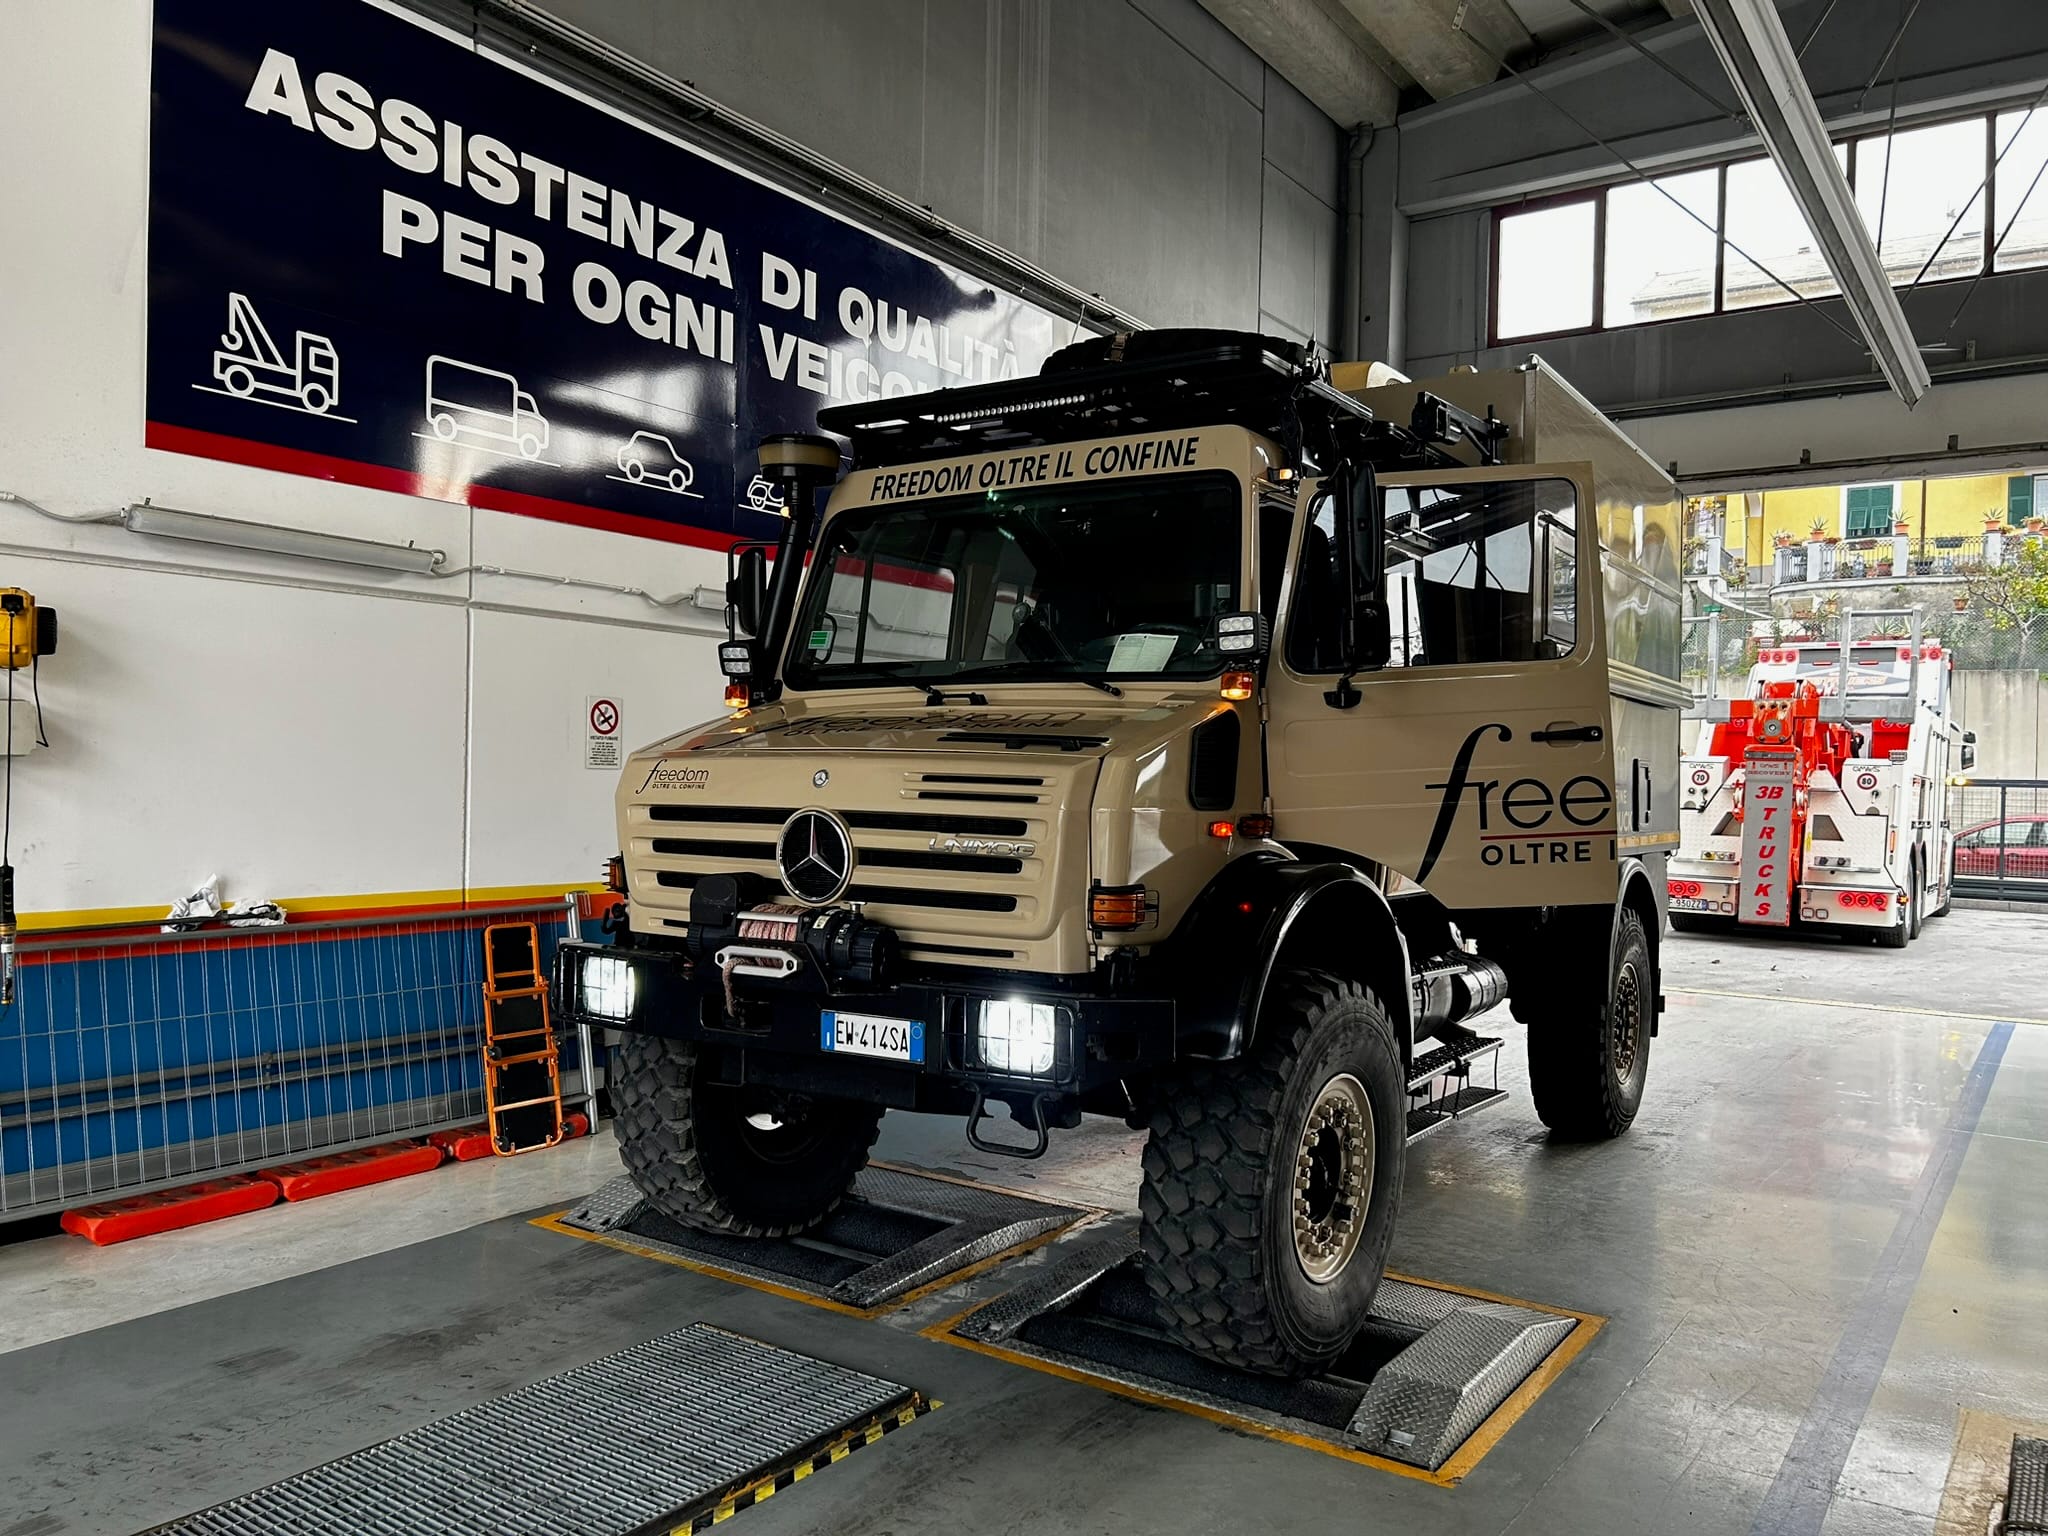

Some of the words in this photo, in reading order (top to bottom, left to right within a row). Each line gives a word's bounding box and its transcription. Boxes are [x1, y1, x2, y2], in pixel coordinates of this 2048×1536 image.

[244, 47, 734, 289] ASSISTENZA
[762, 251, 817, 320] DI
[838, 286, 1020, 381] QUALITÀ
[382, 190, 545, 304] PER
[572, 262, 735, 364] OGNI
[758, 323, 929, 402] VEICO
[870, 463, 974, 501] FREEDOM
[978, 454, 1050, 487] OLTRE
[1054, 450, 1074, 479] IL
[1084, 436, 1200, 475] CONFINE
[635, 759, 710, 794] freedom
[1695, 773, 1706, 782] 70
[1755, 785, 1784, 800] 3B
[1861, 777, 1873, 785] 80
[1415, 723, 1613, 885] free
[928, 837, 1036, 857] UNIMOG
[1480, 840, 1592, 867] OLTRE
[1754, 807, 1777, 916] TRUCKS
[836, 1020, 854, 1046] EW
[860, 1023, 909, 1053] 414SA
